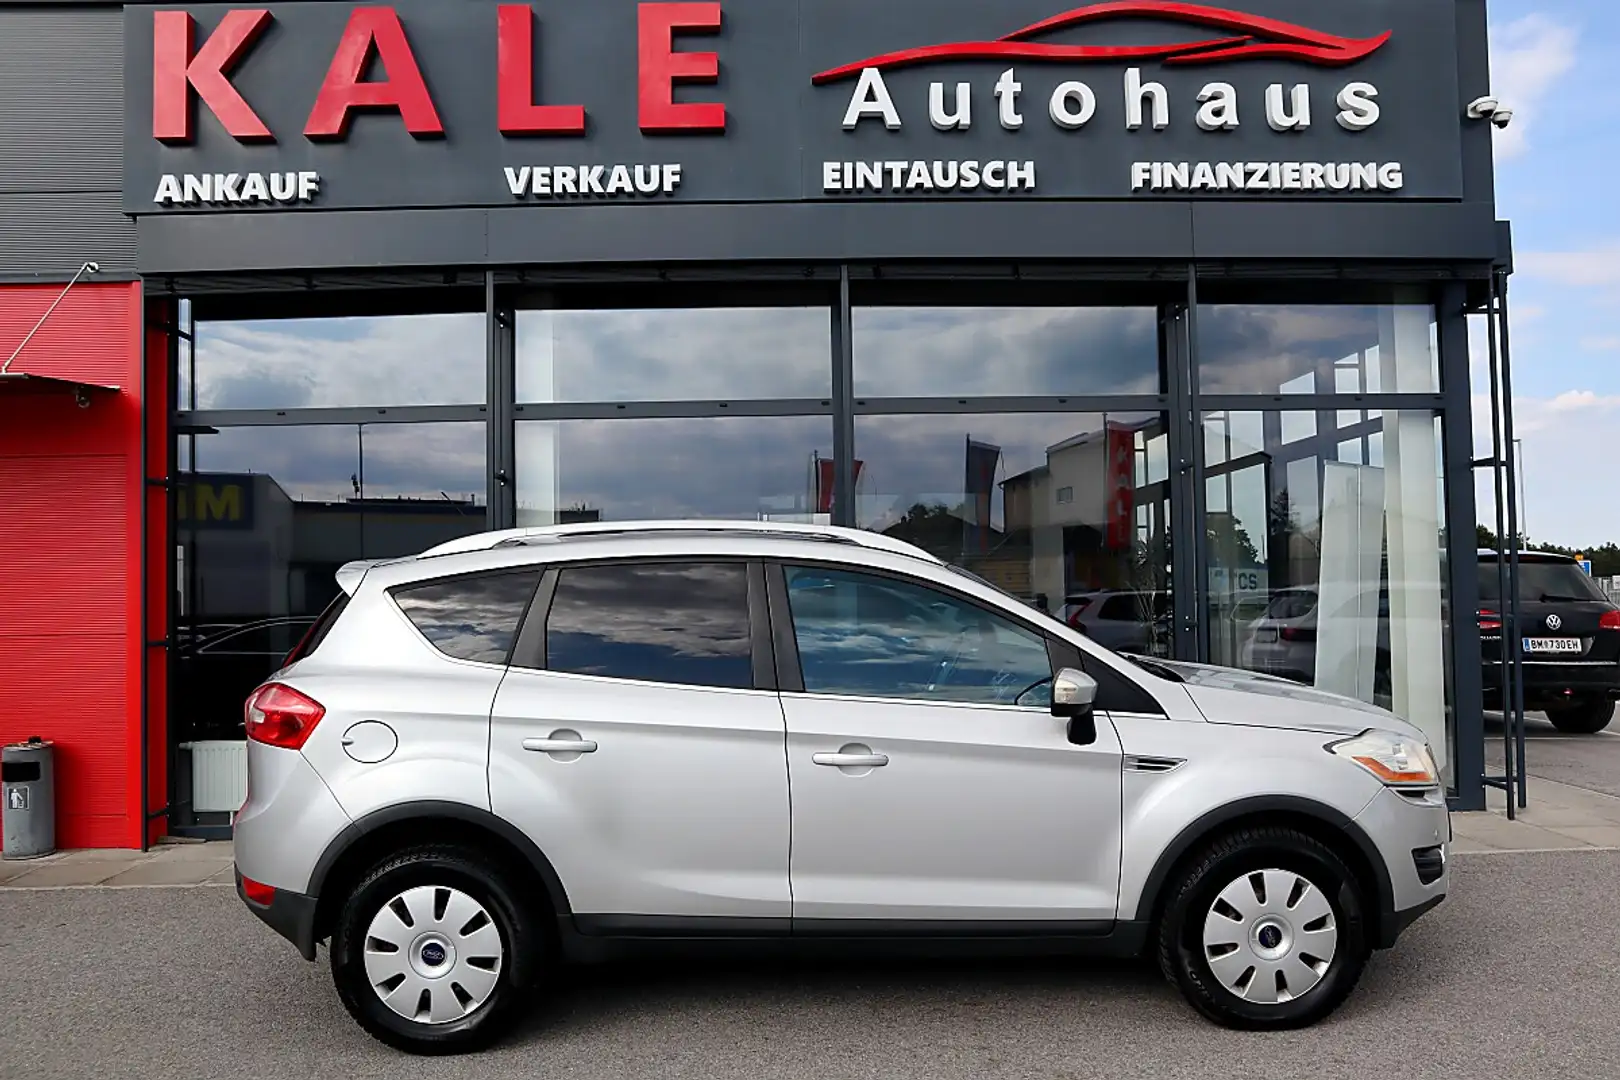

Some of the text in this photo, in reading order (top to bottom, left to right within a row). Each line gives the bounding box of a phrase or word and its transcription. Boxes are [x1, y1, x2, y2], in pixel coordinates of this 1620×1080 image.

[152, 1, 726, 145] KALE
[842, 66, 1383, 132] Autohaus
[153, 160, 1404, 206] ANKAUF VERKAUF EINTAUSCH FINANZIERUNG
